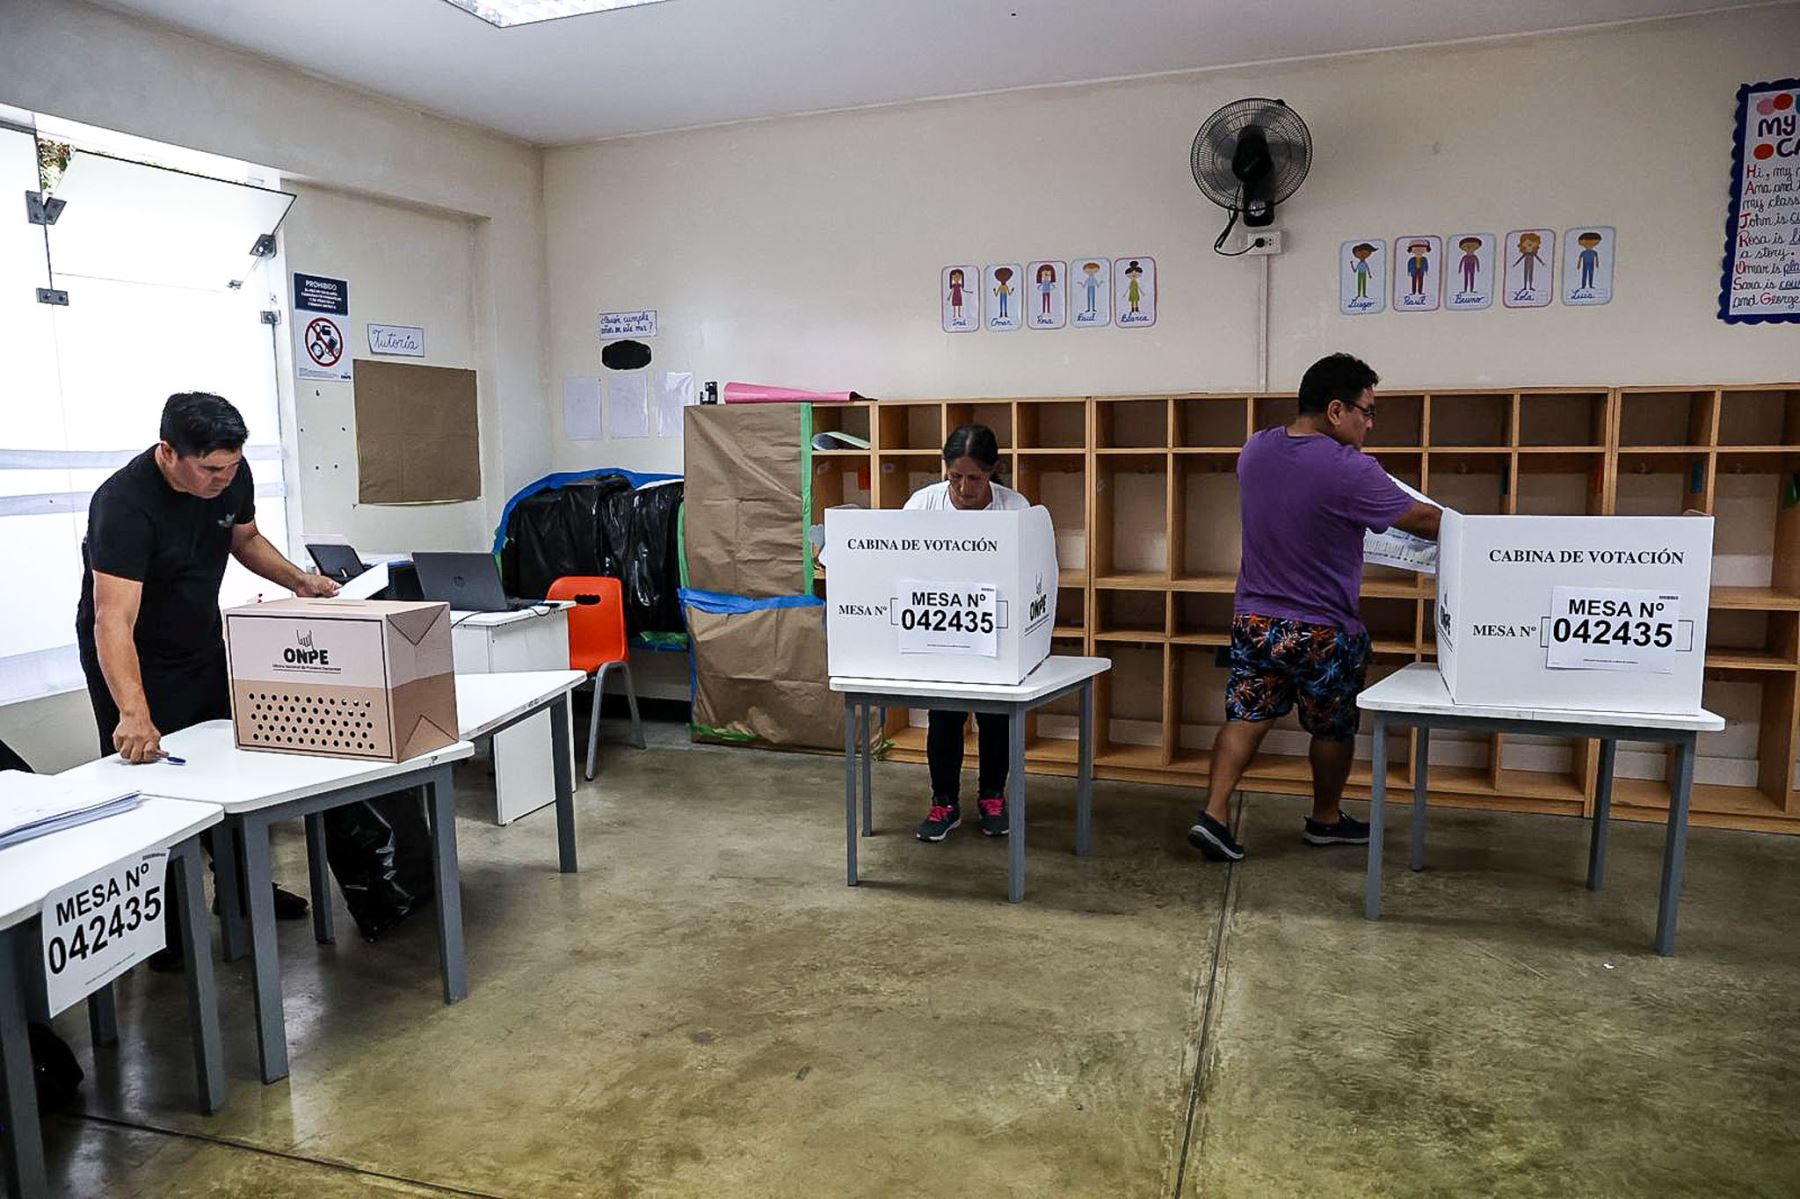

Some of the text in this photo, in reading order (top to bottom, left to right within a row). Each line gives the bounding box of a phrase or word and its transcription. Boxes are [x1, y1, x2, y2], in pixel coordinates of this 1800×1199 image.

[847, 537, 998, 552] CABINA DE VOTACIÓN
[1489, 547, 1685, 565] CABINA DE VOTACIÓN
[911, 591, 963, 608] MESA
[1568, 598, 1633, 618] MESA
[838, 604, 872, 616] MESA
[901, 608, 994, 634] 042435
[1472, 624, 1515, 637] MESA
[1553, 617, 1673, 648] 042435
[283, 648, 329, 665] ONPE
[56, 877, 121, 926] MESA
[49, 885, 161, 975] 042435
